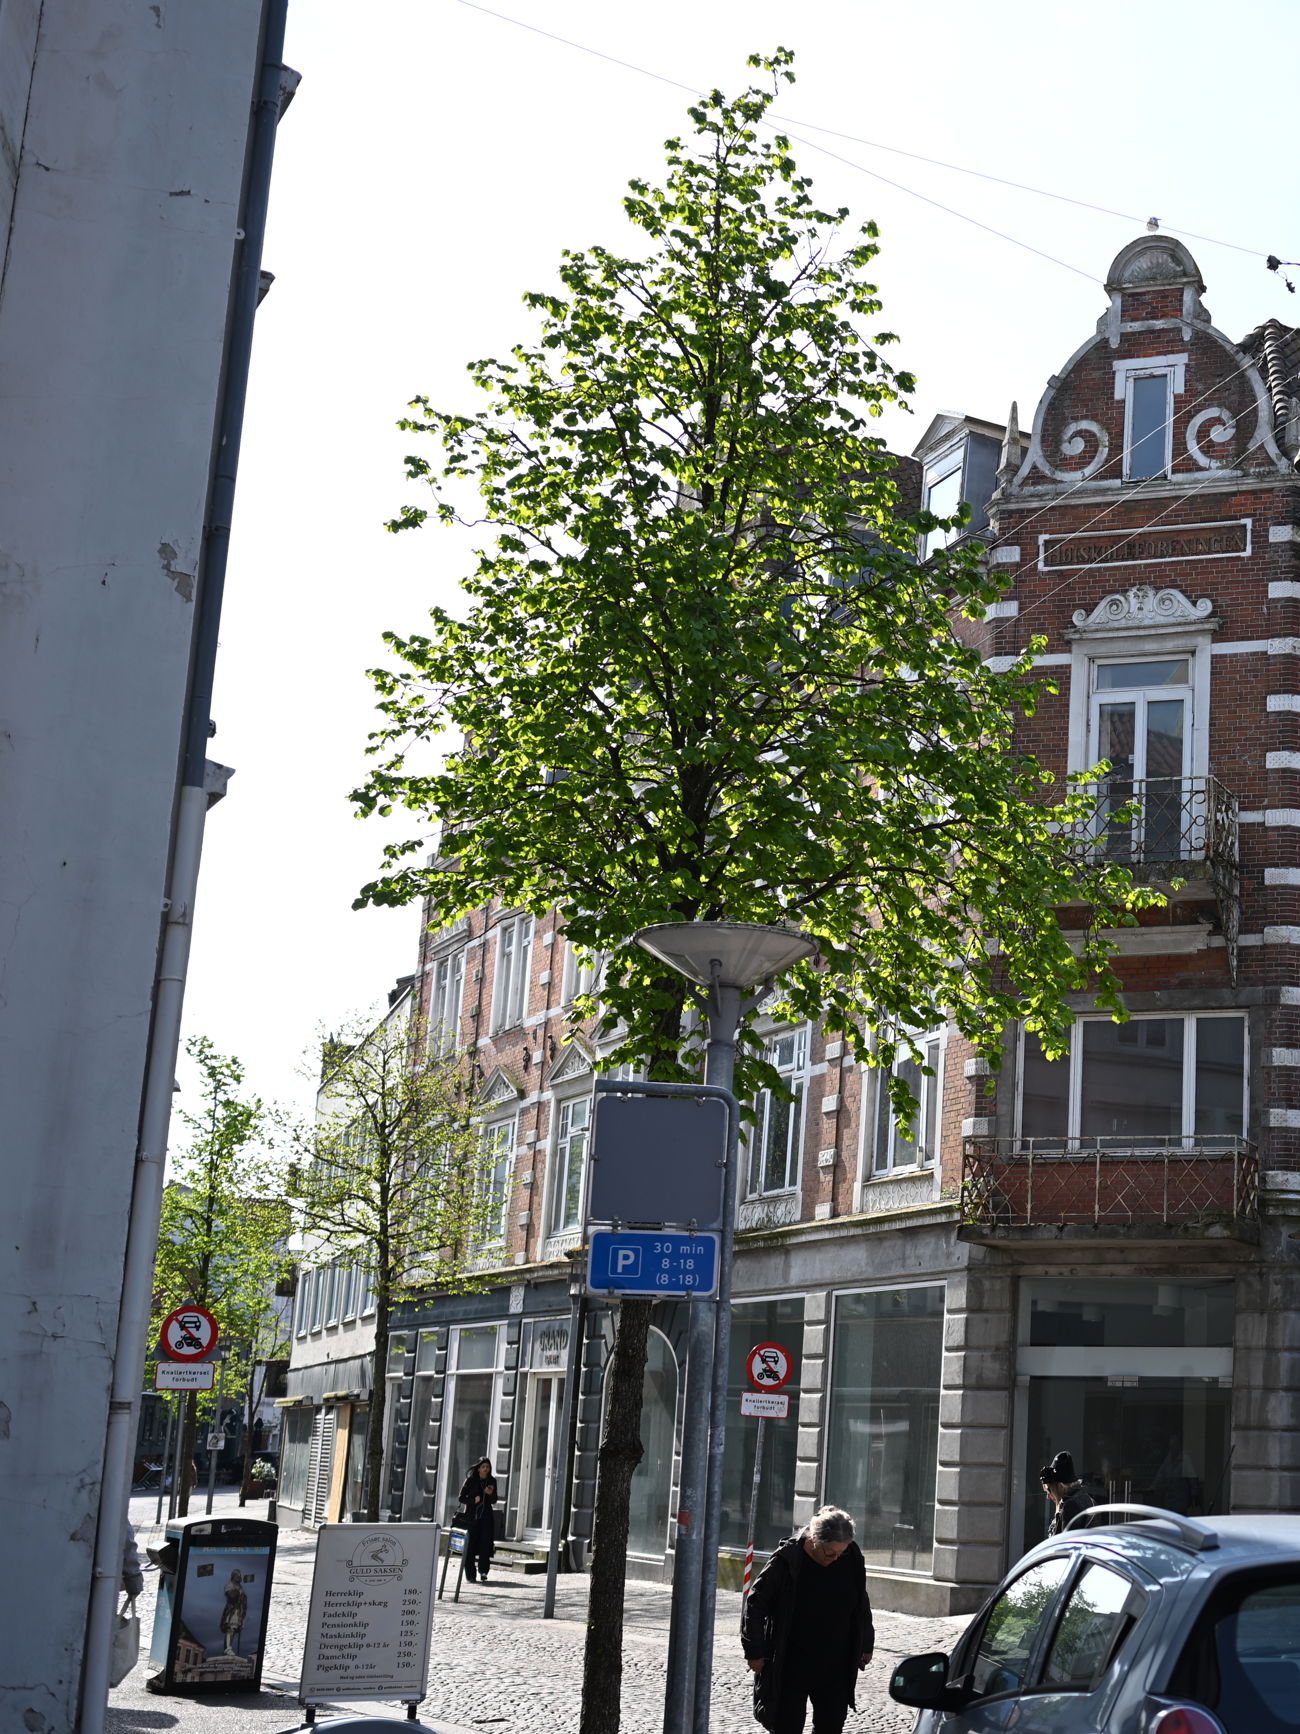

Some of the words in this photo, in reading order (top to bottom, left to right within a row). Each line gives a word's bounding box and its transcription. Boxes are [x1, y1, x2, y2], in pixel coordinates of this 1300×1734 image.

[653, 1242, 672, 1254] 30
[680, 1243, 704, 1255] min
[617, 1249, 635, 1273] P
[325, 1590, 364, 1598] Herreklip
[321, 1621, 369, 1629] Pensionklip
[320, 1632, 367, 1640] Maskinklip
[319, 1642, 364, 1651] Drengeklip
[318, 1653, 358, 1661] Dameklip
[316, 1663, 350, 1672] Pigeklip
